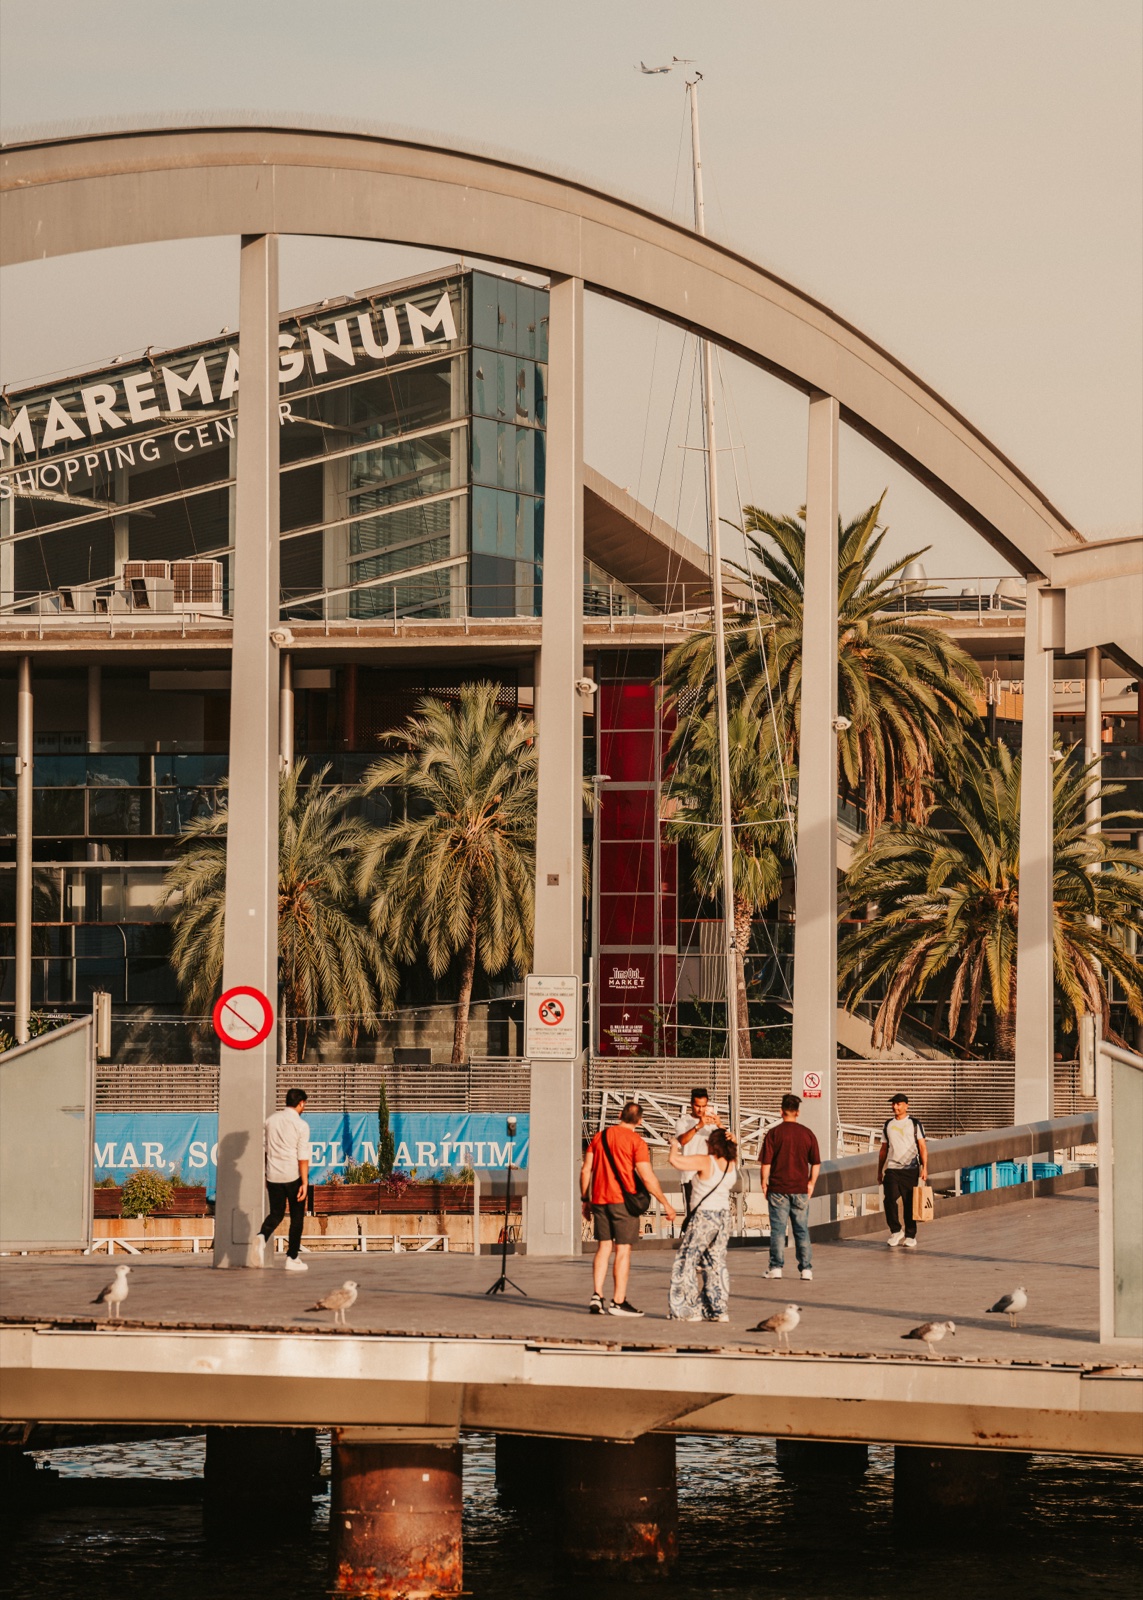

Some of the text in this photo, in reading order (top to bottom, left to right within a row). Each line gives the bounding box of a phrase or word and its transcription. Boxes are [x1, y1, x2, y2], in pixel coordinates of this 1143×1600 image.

[0, 402, 296, 499] SHOPPING CENR
[94, 1142, 176, 1173] MAR,
[361, 1132, 517, 1168] MARÍTIM
